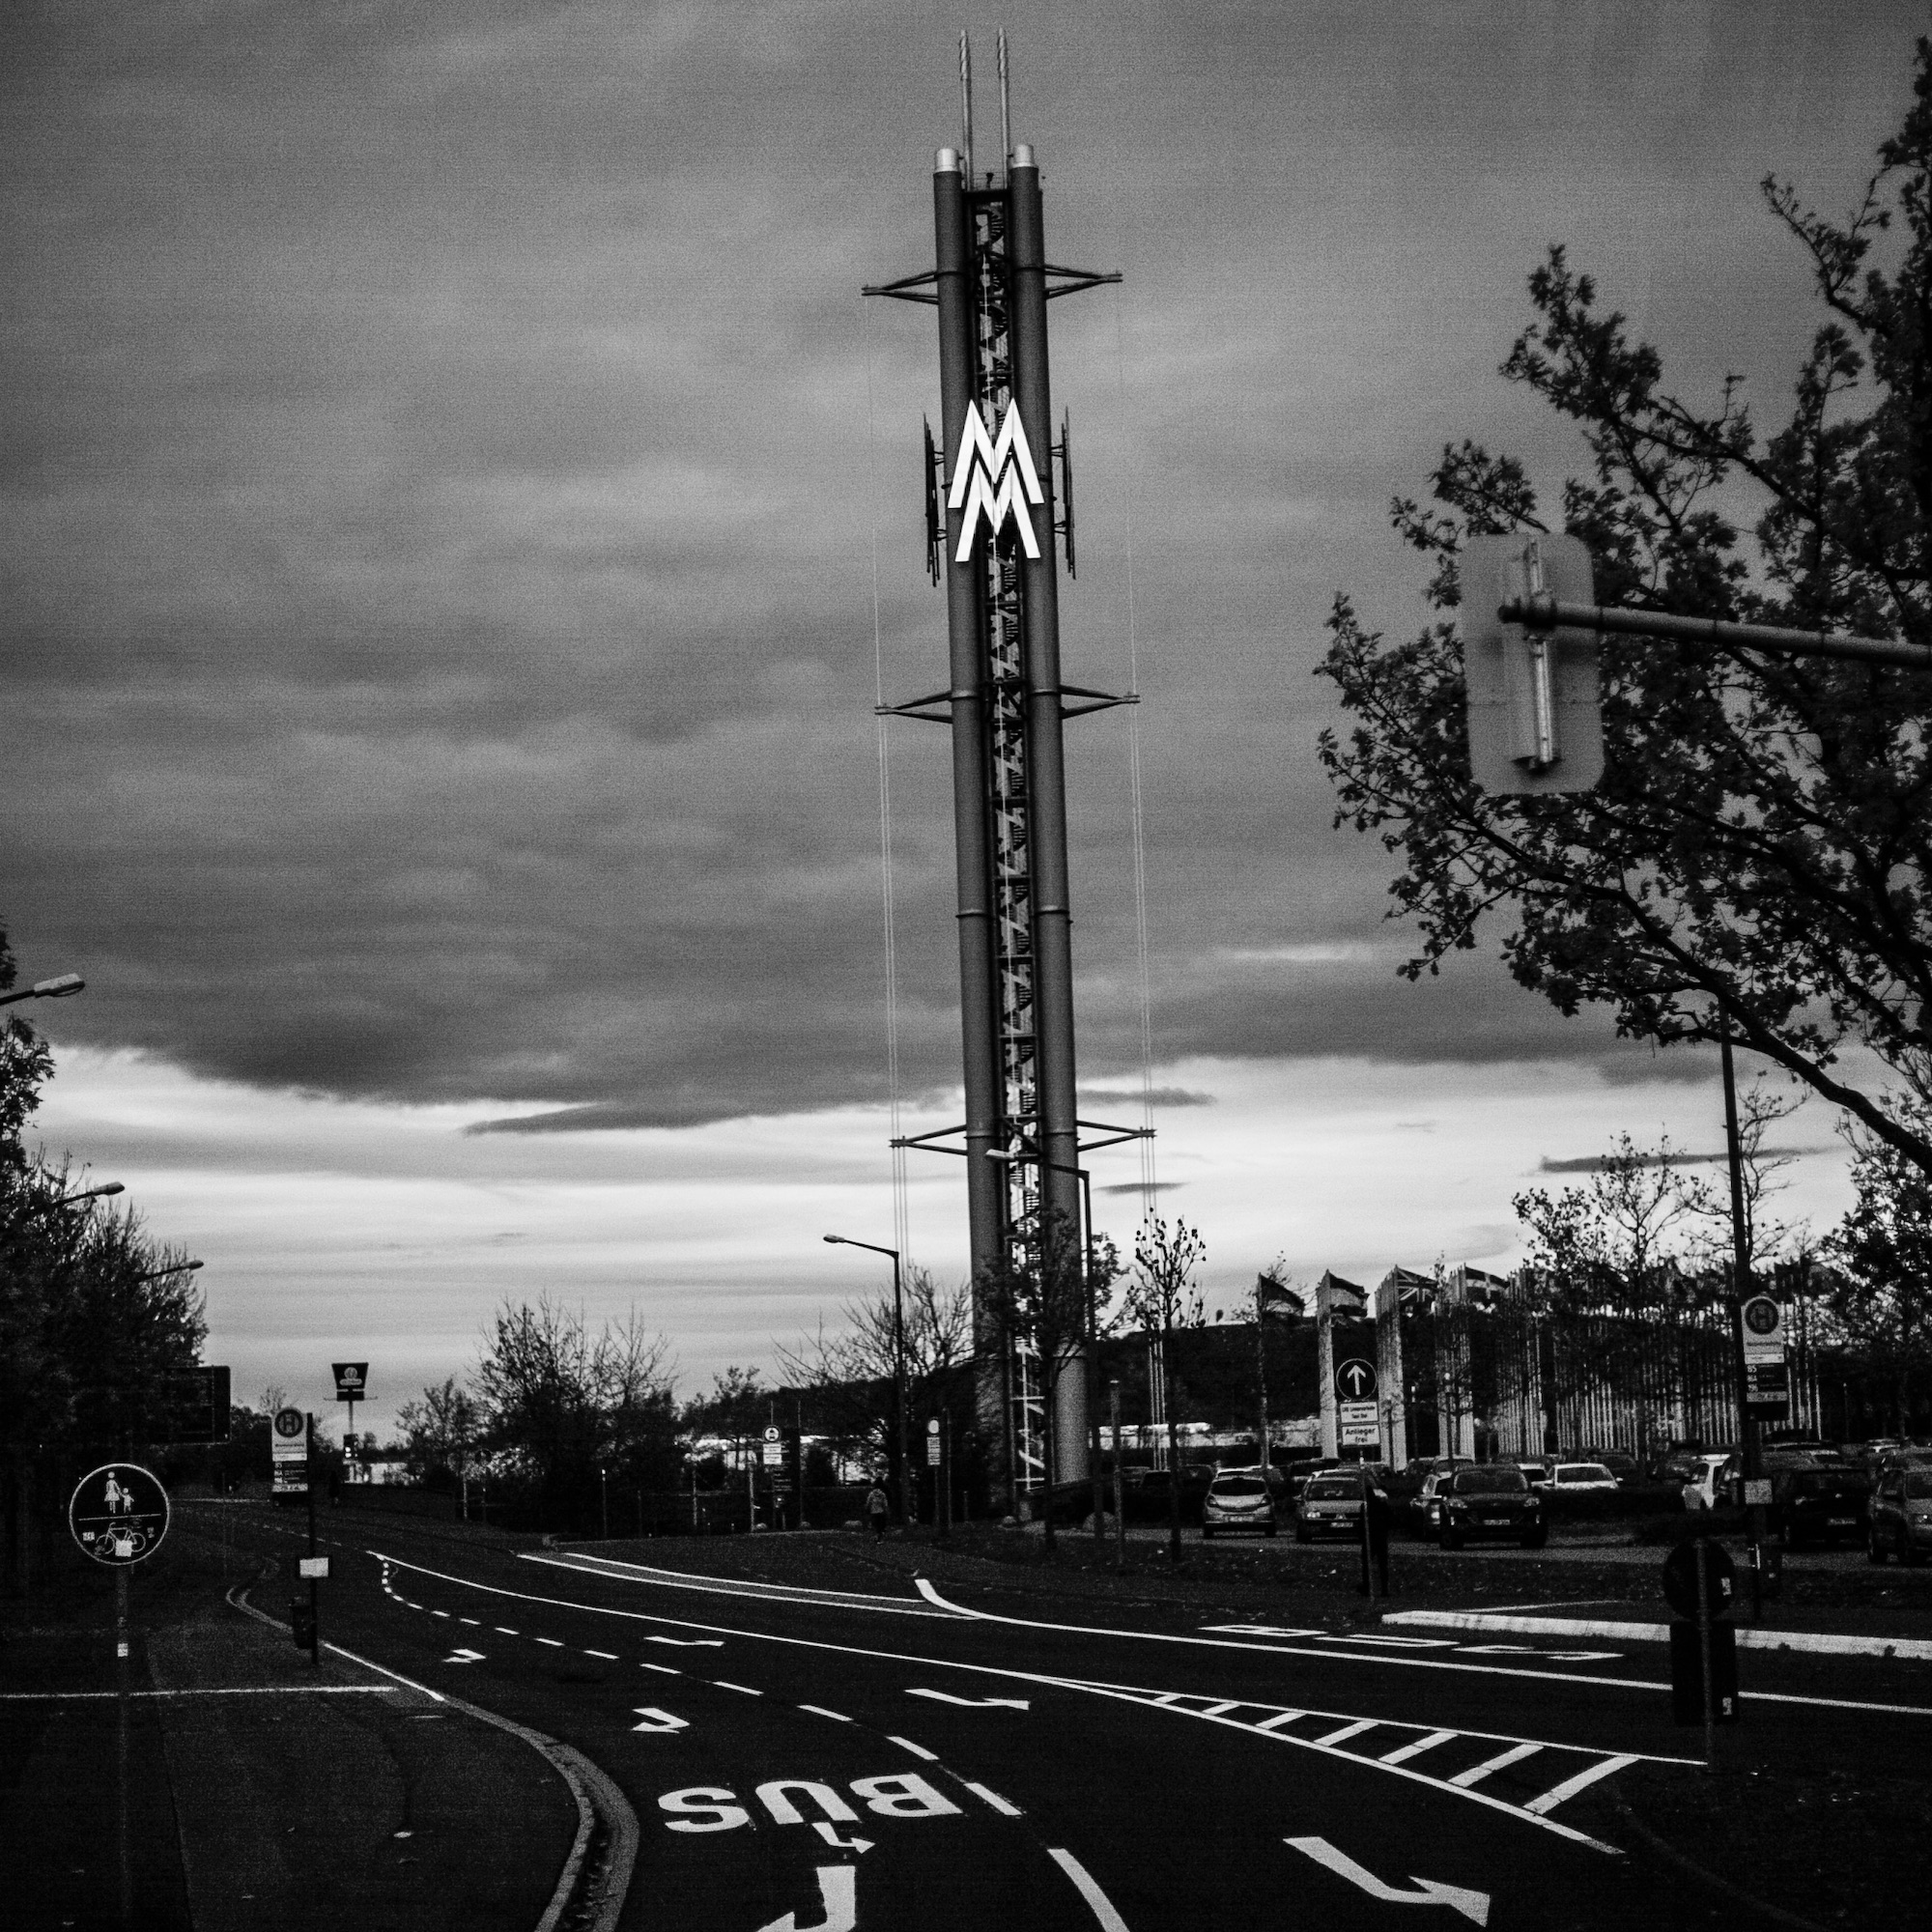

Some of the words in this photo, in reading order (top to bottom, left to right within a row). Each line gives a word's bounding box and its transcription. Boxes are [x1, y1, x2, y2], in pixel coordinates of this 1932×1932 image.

[283, 1413, 296, 1432] H
[1196, 1623, 1625, 1662] BUS
[657, 1772, 964, 1833] BUS
